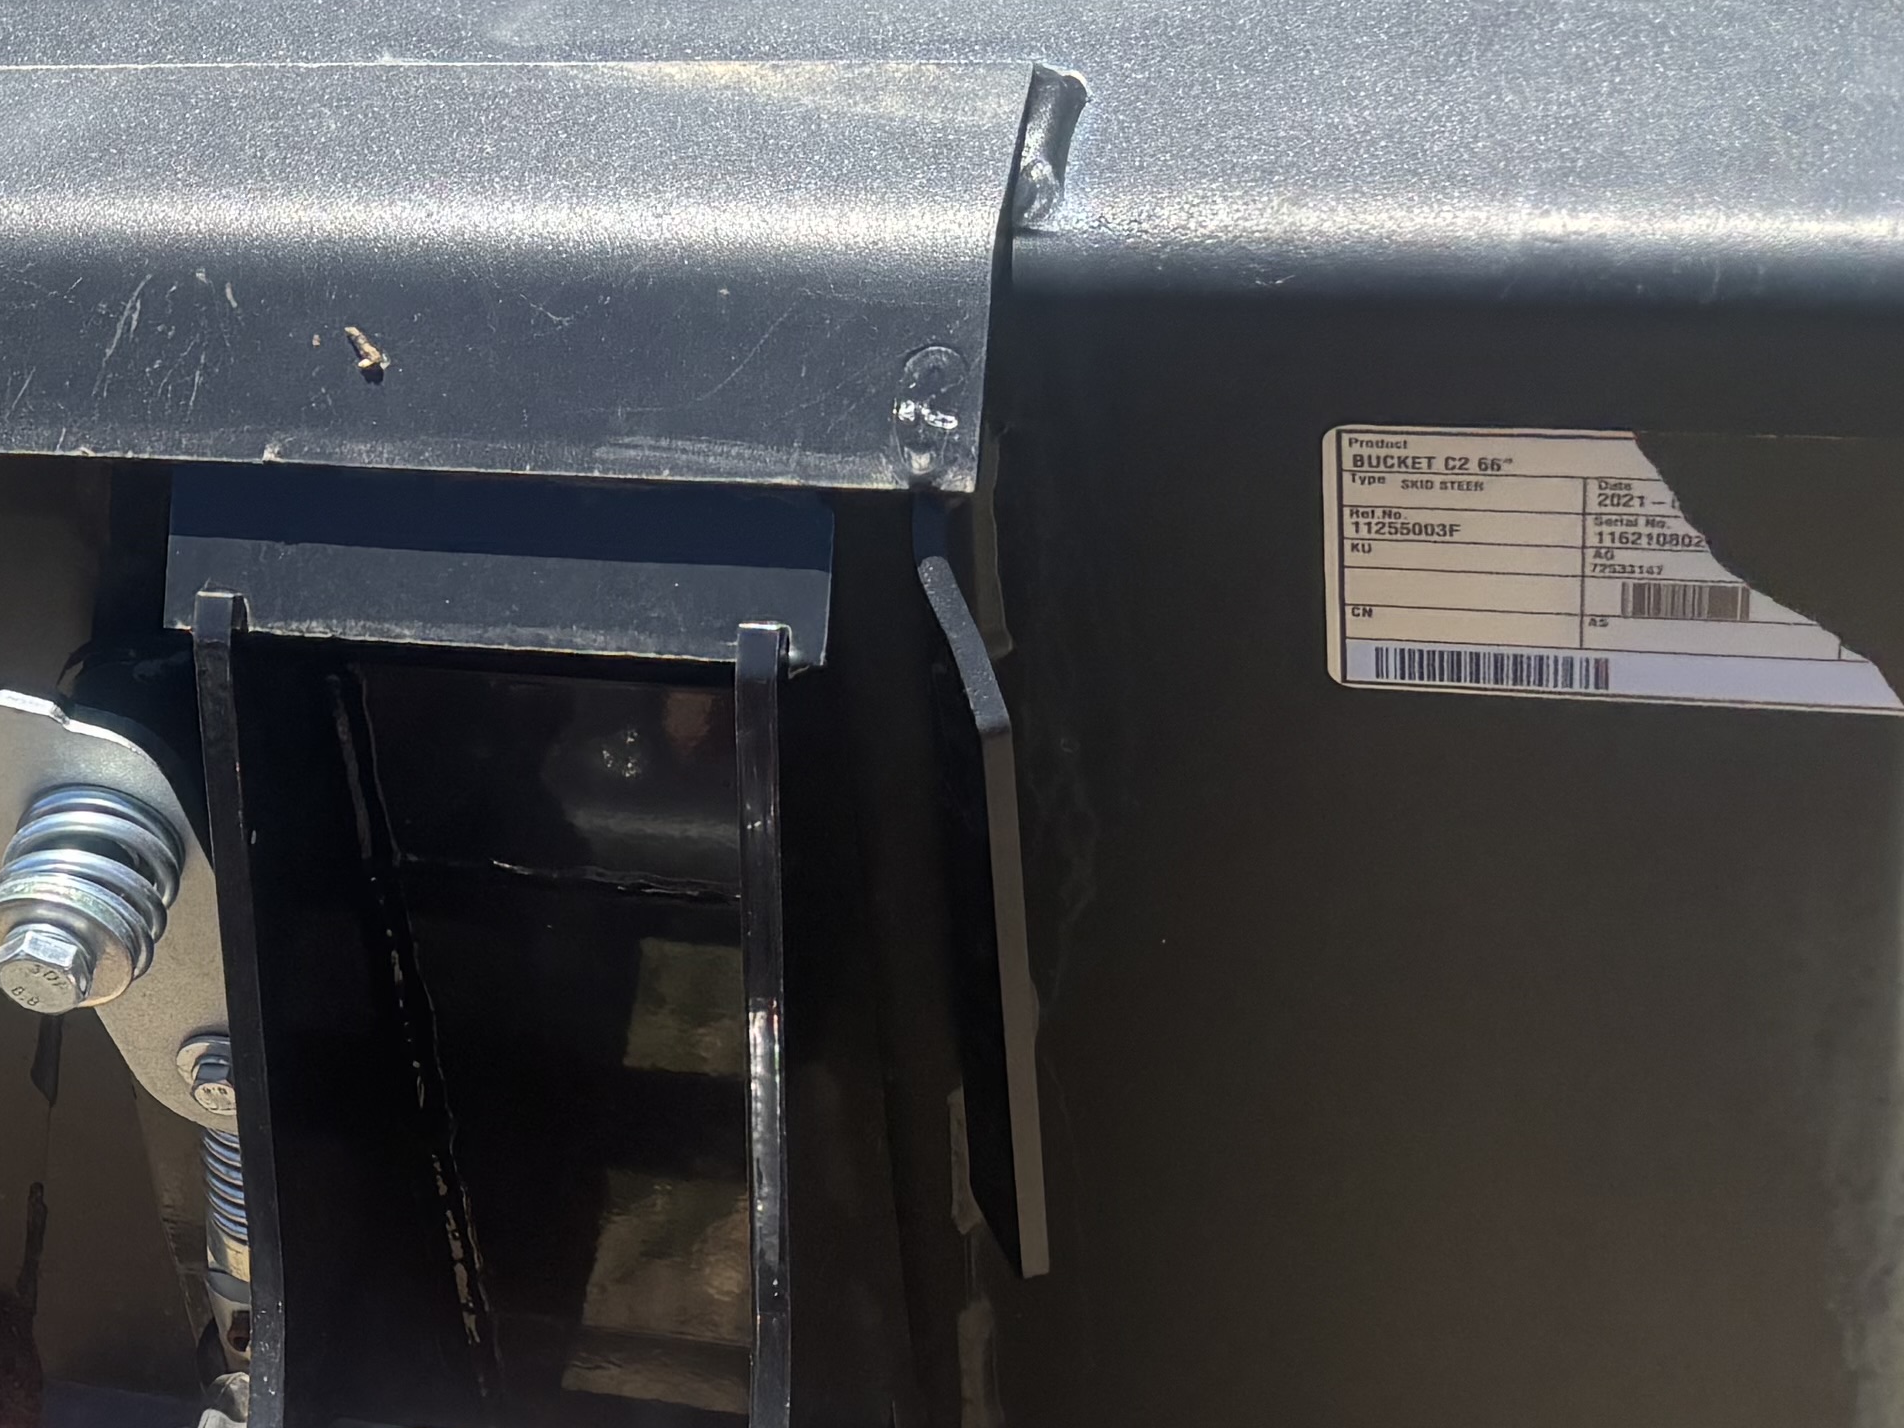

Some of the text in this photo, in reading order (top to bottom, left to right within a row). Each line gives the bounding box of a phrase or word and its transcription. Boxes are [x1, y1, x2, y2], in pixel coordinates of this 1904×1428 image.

[1348, 437, 1408, 450] Product
[1352, 453, 1436, 471] BUCKET
[1444, 456, 1470, 471] C2
[1350, 473, 1484, 492] Type SKID STEER
[1598, 480, 1632, 491] Date
[1597, 493, 1645, 508] 2021
[1351, 521, 1461, 537] 11255003F
[1594, 516, 1671, 529] Serial No.
[1351, 607, 1373, 618] CN
